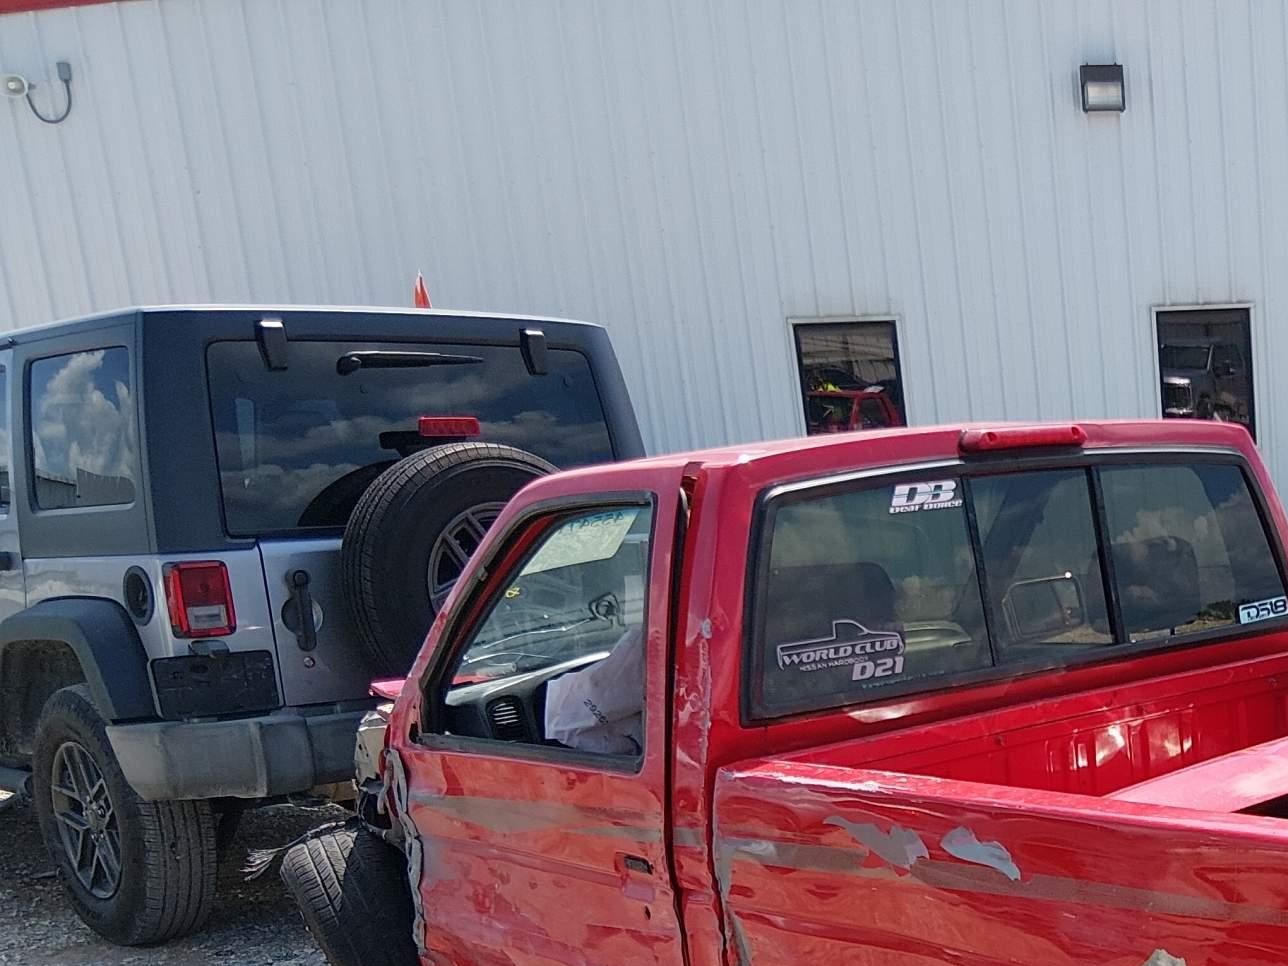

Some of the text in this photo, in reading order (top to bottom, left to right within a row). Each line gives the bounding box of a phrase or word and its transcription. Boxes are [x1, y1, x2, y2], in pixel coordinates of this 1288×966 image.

[891, 480, 957, 507] DB
[782, 639, 898, 666] WORLD CLUB
[852, 655, 905, 681] D21
